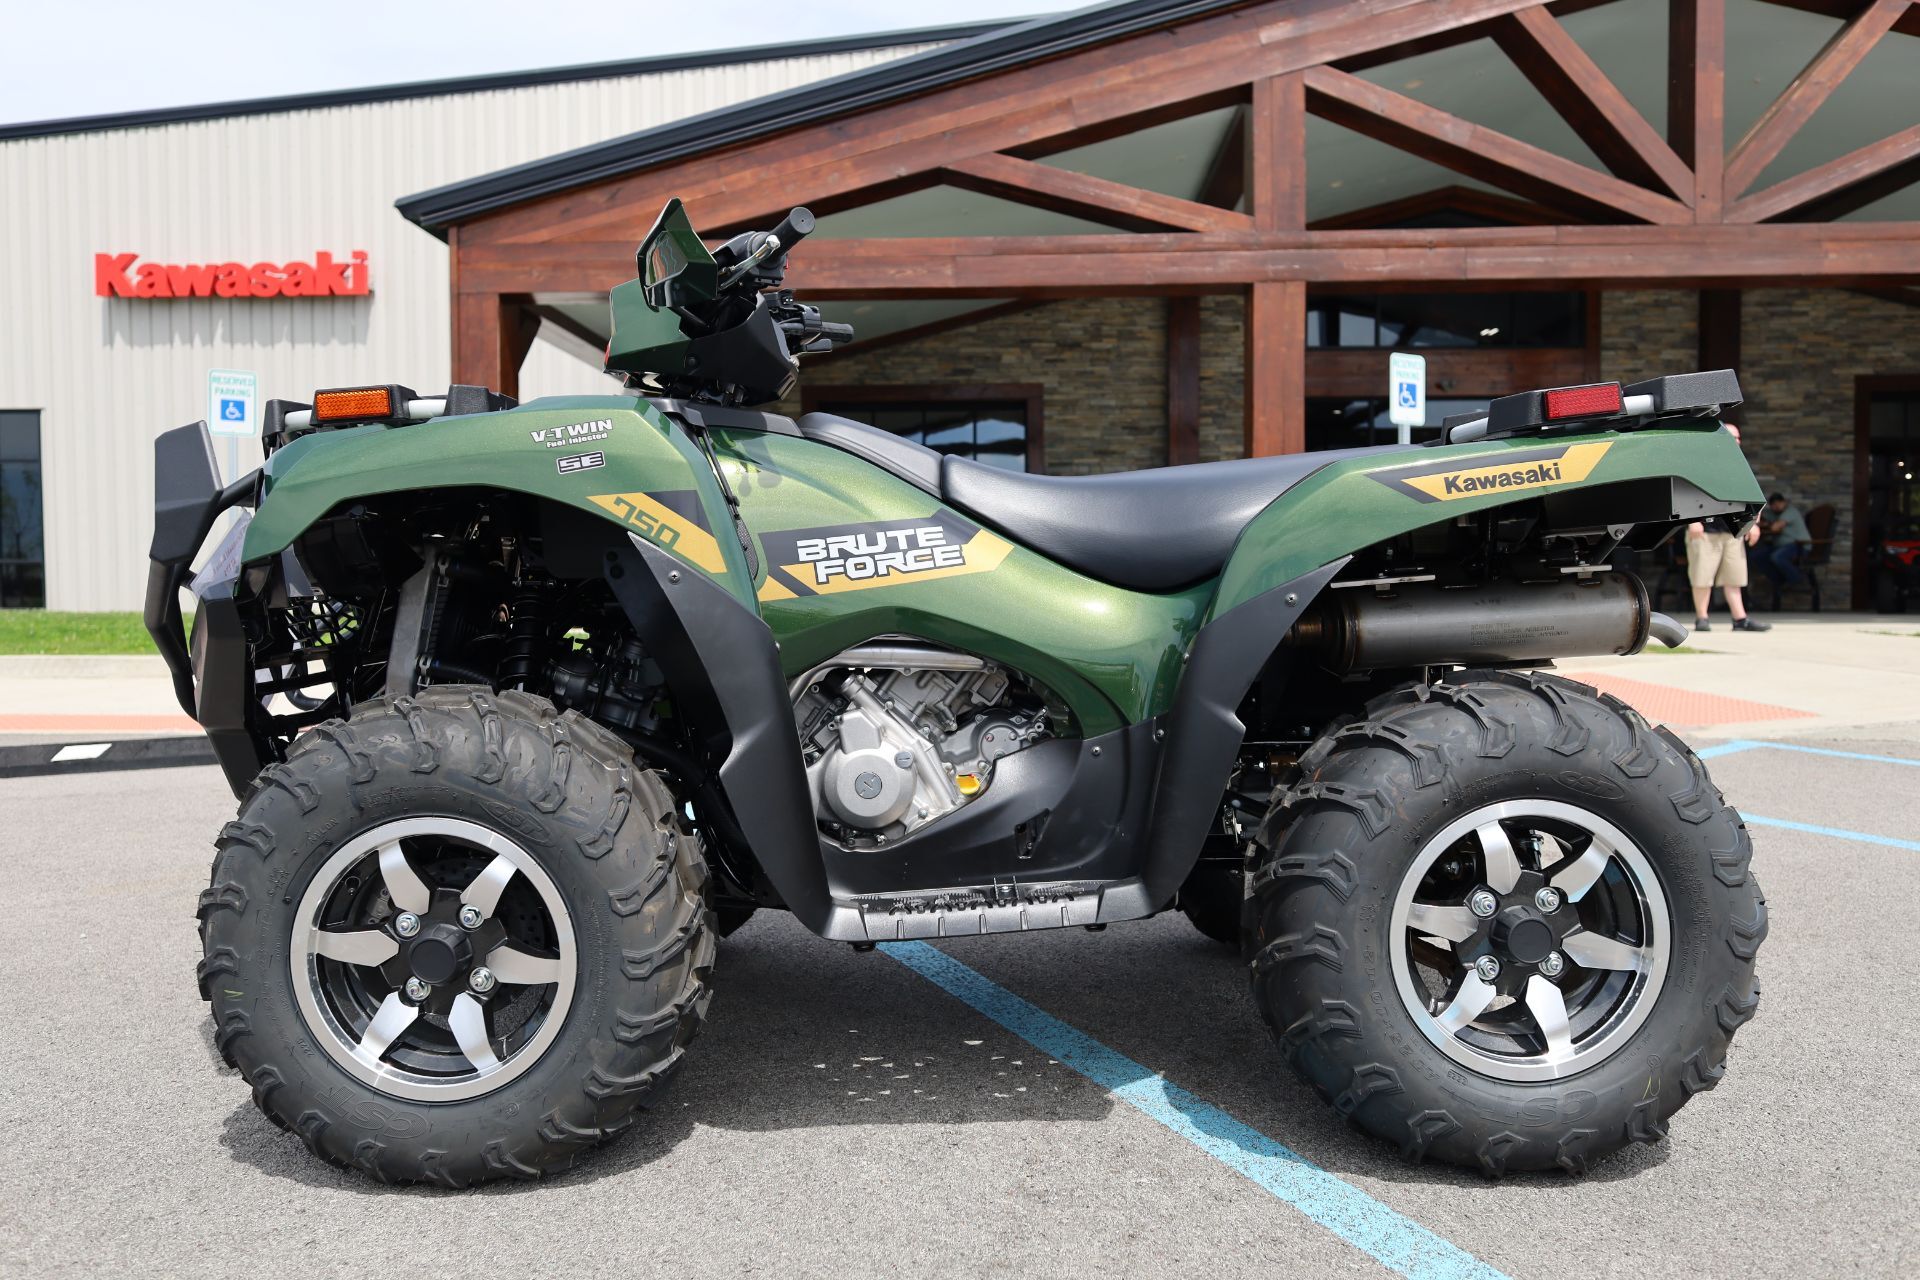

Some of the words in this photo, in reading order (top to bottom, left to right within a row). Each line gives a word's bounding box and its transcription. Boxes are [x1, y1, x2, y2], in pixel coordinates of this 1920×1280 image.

[95, 250, 369, 297] Kawasaki
[530, 418, 613, 443] V-TWIN
[546, 437, 566, 448] Fuel
[559, 453, 603, 472] SE
[1444, 463, 1561, 495] Kawasaki
[613, 496, 681, 549] 750
[797, 526, 947, 562] BRUTE
[815, 544, 966, 584] FORCE
[314, 1085, 428, 1139] CST
